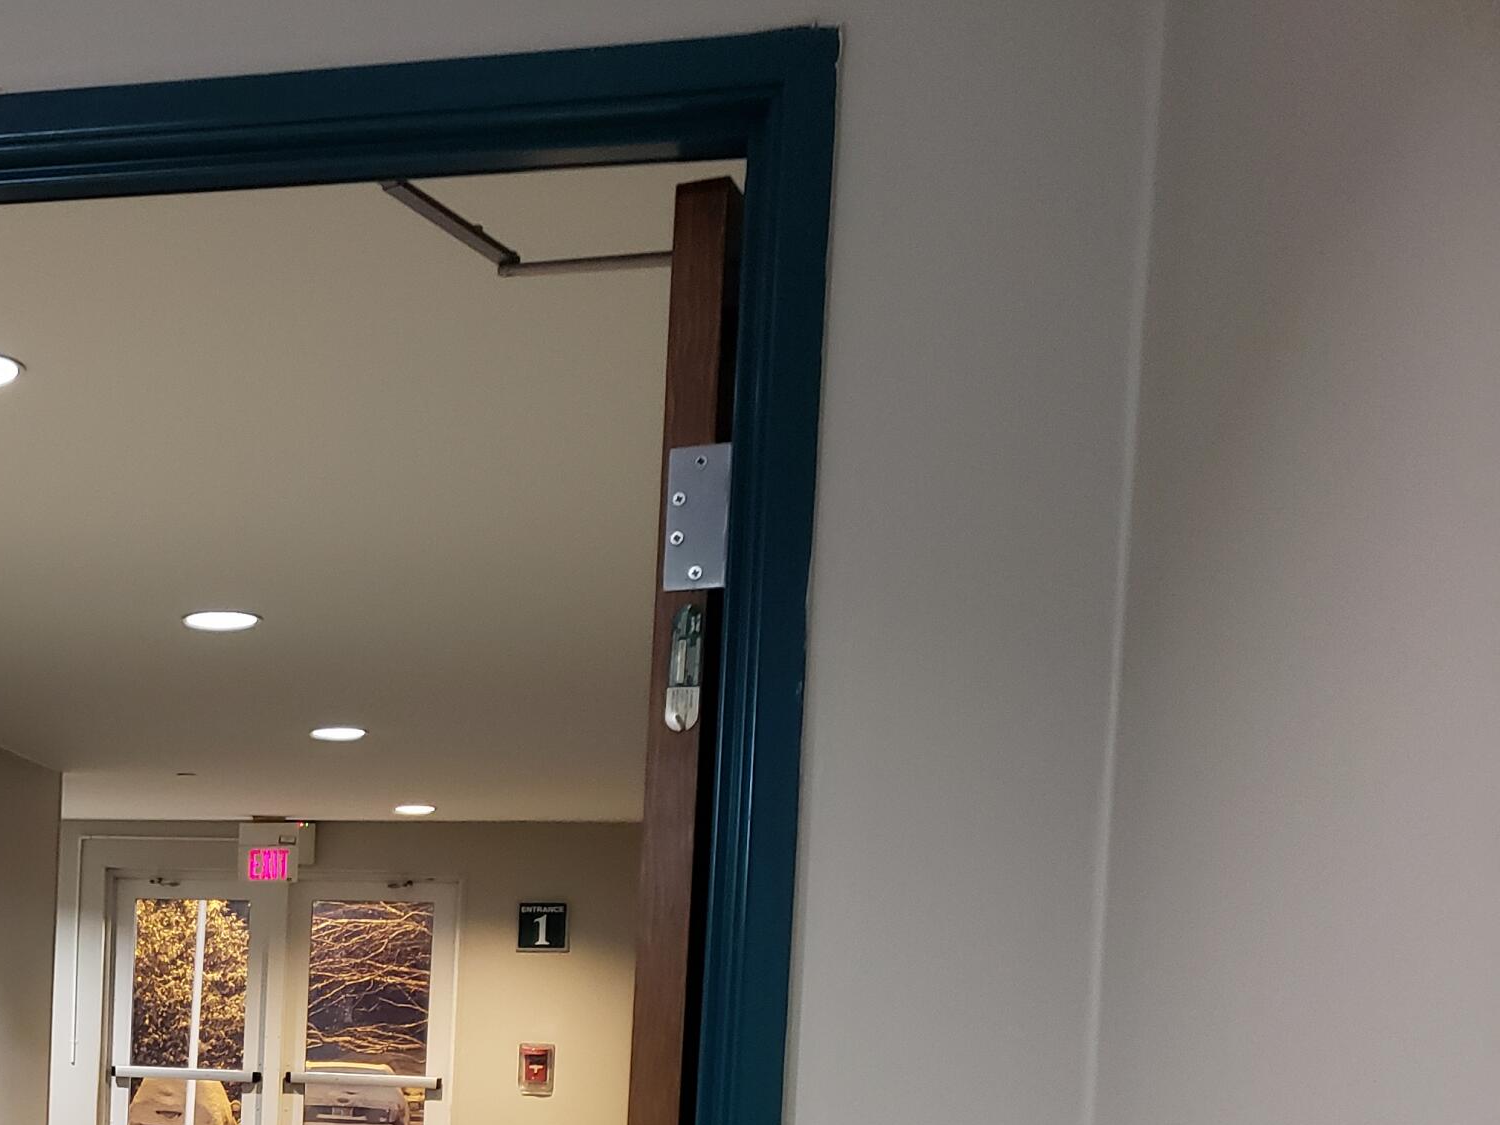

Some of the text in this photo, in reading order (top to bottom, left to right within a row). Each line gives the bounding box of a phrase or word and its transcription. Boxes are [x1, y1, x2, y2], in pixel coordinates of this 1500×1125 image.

[249, 849, 289, 880] EXIT
[521, 906, 564, 914] ENTRANCE
[534, 914, 550, 945] 1
